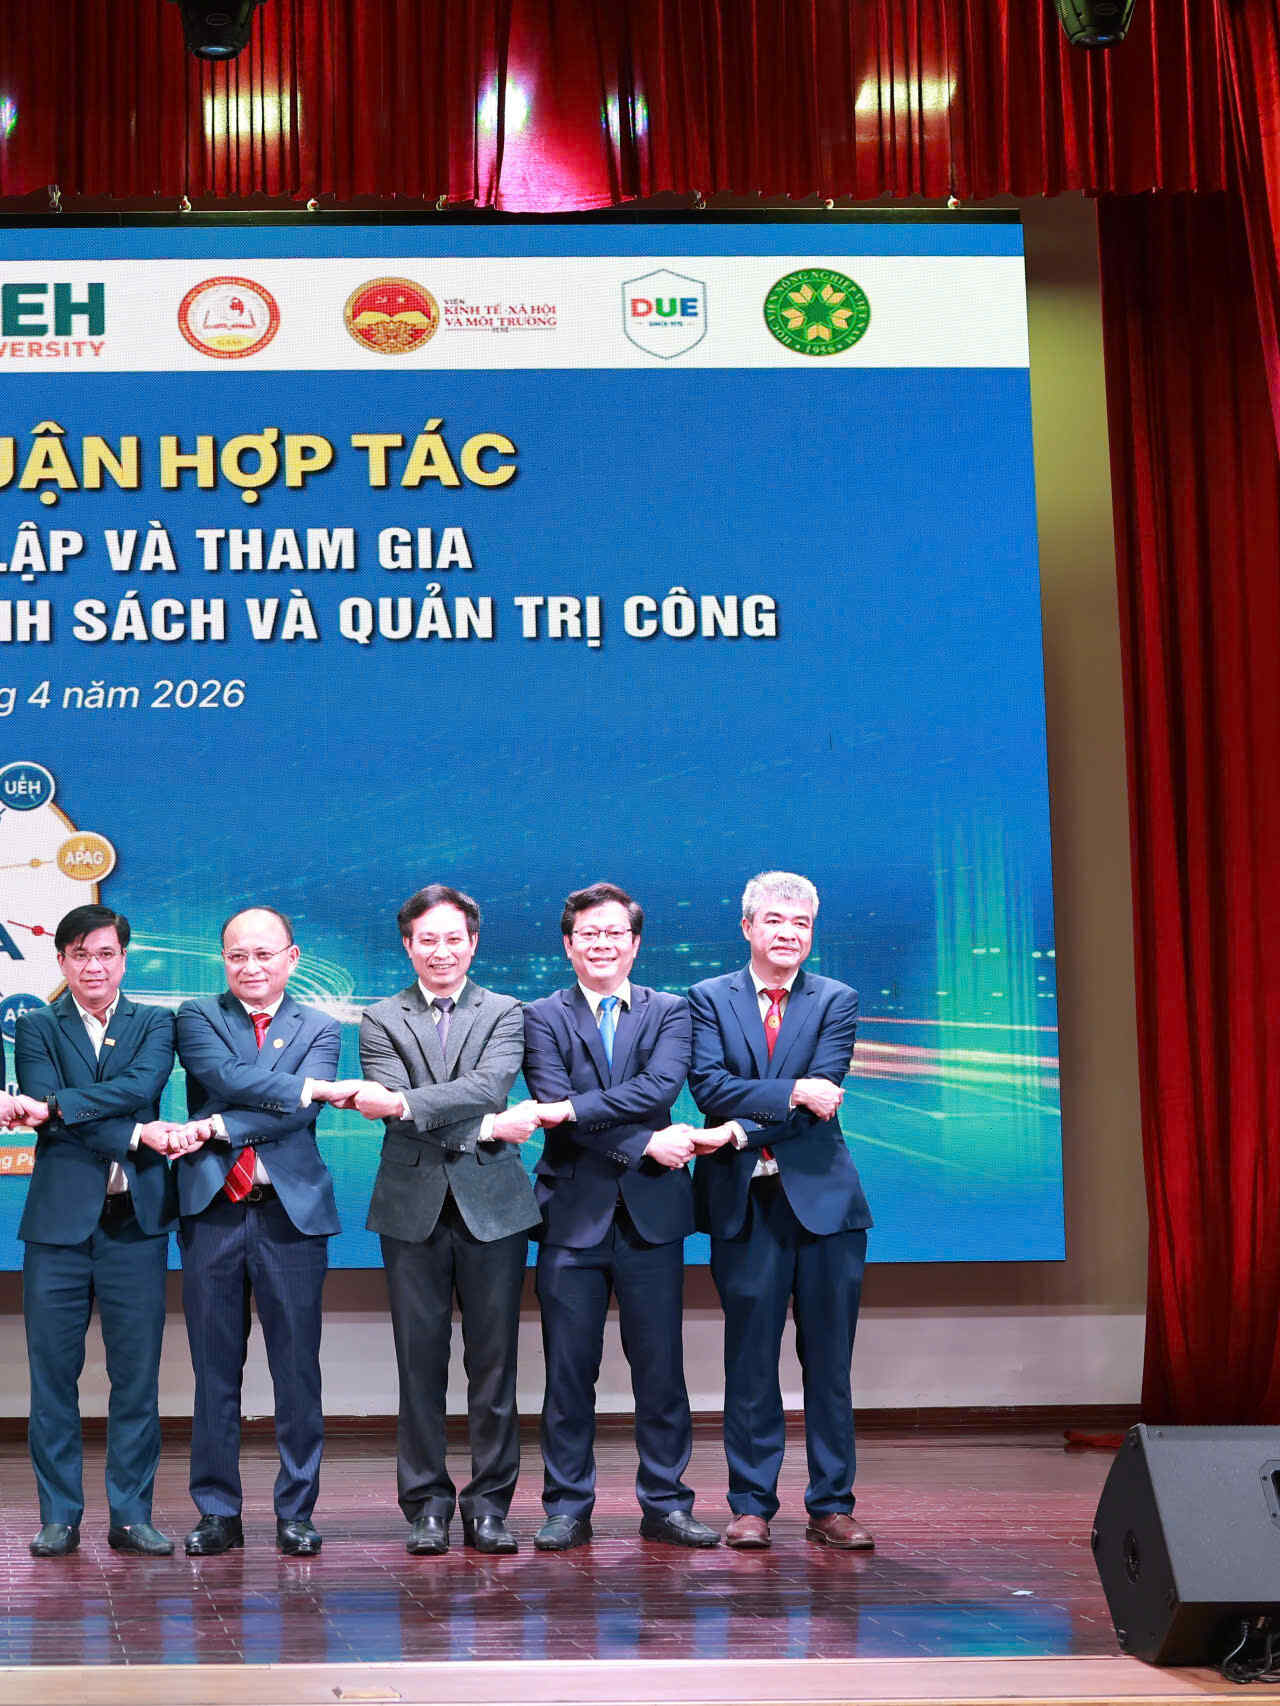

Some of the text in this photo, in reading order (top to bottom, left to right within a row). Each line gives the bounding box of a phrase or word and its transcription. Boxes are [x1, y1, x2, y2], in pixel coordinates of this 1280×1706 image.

[444, 306, 480, 315] KINH
[631, 297, 698, 317] DUE
[160, 428, 333, 503] HỢP
[352, 419, 516, 486] TÁC
[105, 521, 176, 570] VÀ
[196, 528, 354, 570] THAM
[379, 528, 472, 569] GIA
[73, 591, 224, 642] SÁCH
[246, 589, 317, 640] VÀ
[340, 583, 492, 643] QUẢN
[514, 596, 600, 647] TRỊ
[624, 587, 776, 638] CÔNG
[27, 681, 51, 708] 4
[63, 680, 140, 708] năm
[151, 680, 246, 708] 2026
[4, 780, 41, 795] UEH
[65, 850, 105, 865] APAG
[4, 1007, 33, 1022] AP
